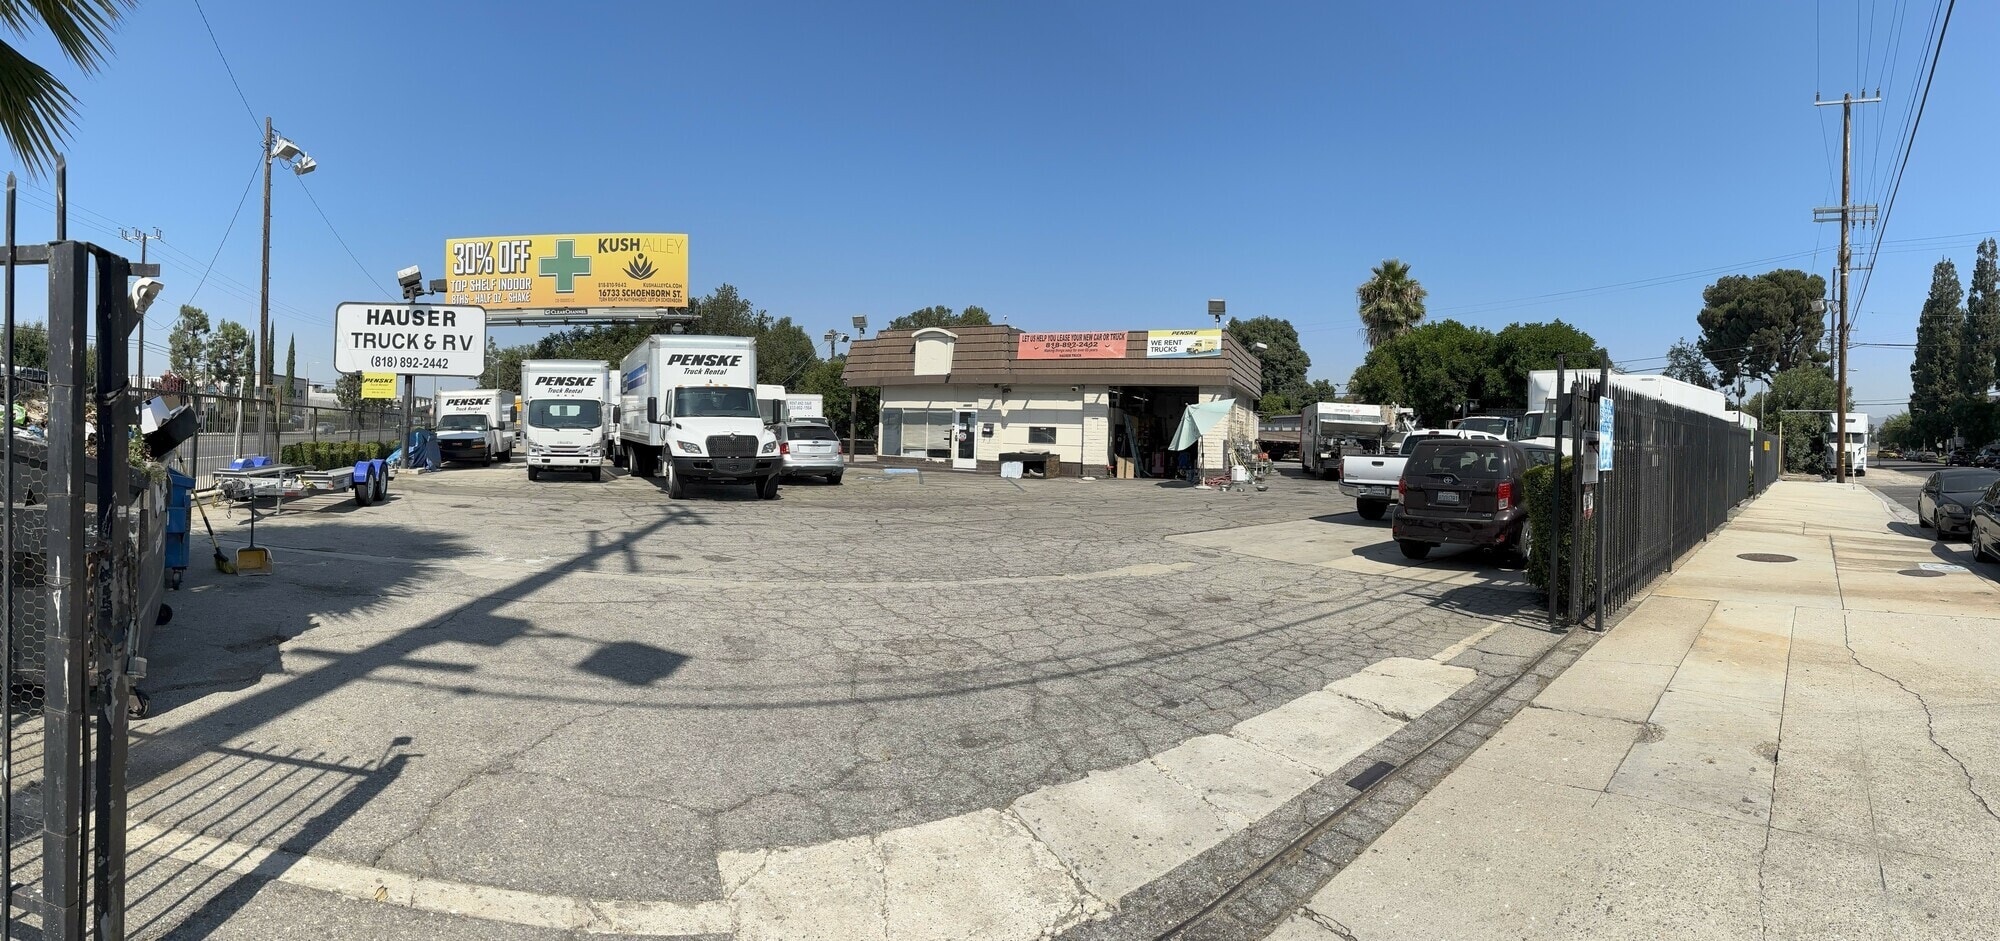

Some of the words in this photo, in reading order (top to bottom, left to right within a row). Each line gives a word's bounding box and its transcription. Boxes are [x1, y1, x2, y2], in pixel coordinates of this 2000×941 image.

[598, 238, 683, 254] KUSHALLEY
[453, 241, 494, 276] 30%
[498, 240, 532, 274] OFF
[450, 280, 468, 292] TOP
[469, 279, 496, 292] SHELF
[498, 277, 532, 290] INDOOR
[451, 294, 469, 304] 8THS
[475, 293, 492, 304] HALF
[493, 293, 502, 303] OZ
[508, 292, 531, 303] SHAKE
[598, 289, 620, 297] 16733
[621, 289, 670, 297] SCHOENBORN
[672, 290, 682, 298] ST.
[366, 309, 456, 327] HAUSER
[351, 332, 419, 350] TRUCK
[424, 333, 437, 350] &
[442, 334, 474, 351] RV
[370, 355, 397, 368] (818)
[400, 357, 449, 369] 892-2442
[667, 354, 742, 366] PENSKE
[535, 376, 597, 387] PENSKE
[445, 397, 492, 406] PENSKE
